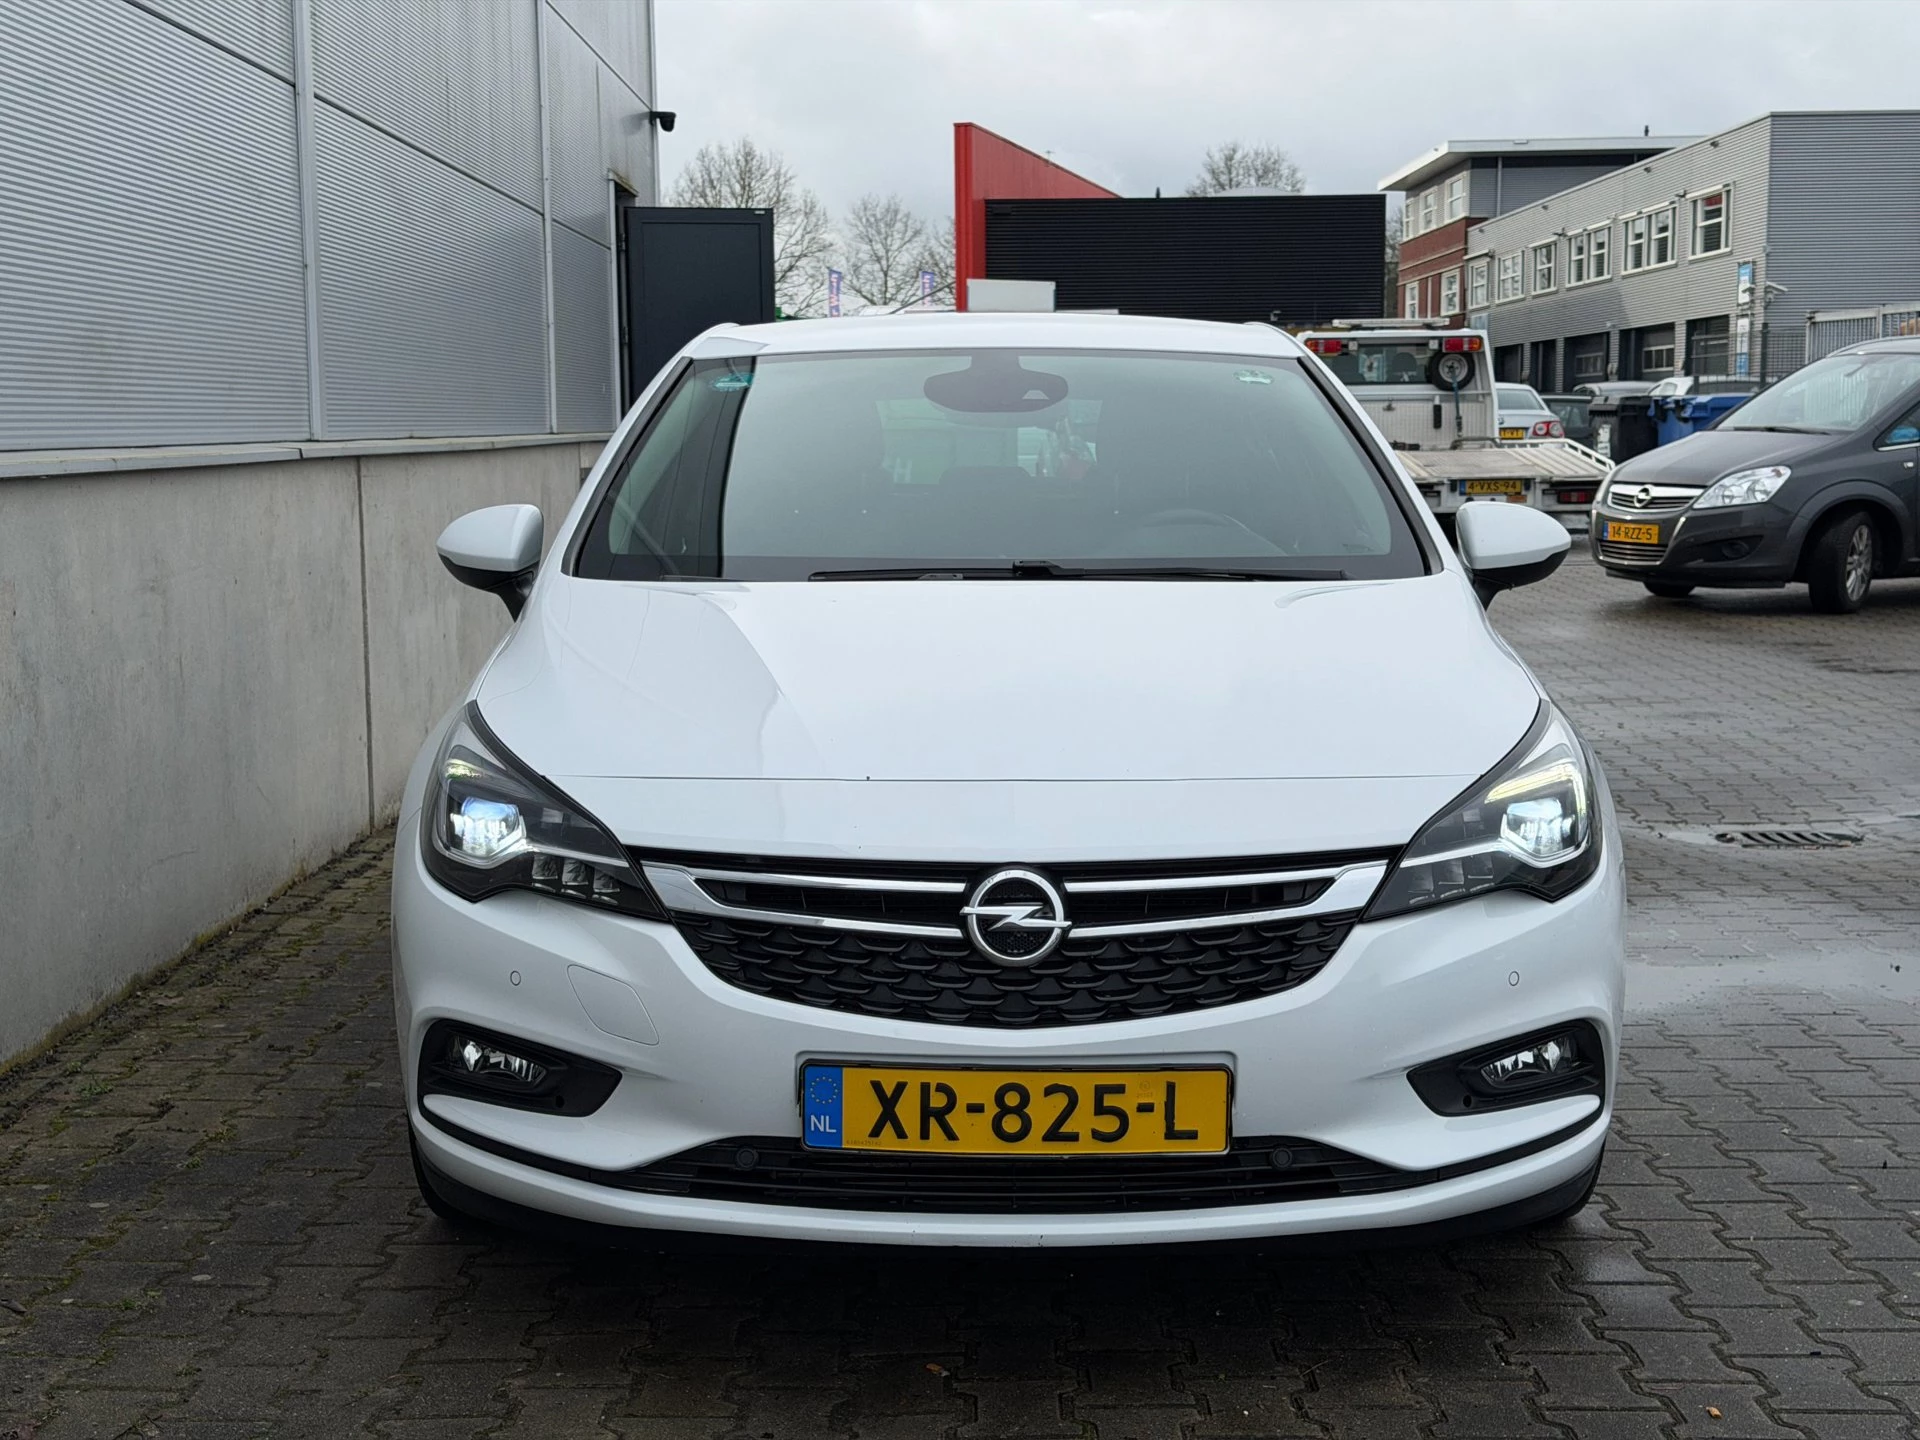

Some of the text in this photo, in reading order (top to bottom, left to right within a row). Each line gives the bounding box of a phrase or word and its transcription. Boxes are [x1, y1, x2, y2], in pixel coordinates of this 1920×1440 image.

[1611, 525, 1653, 541] 14-RZZ-5
[868, 1080, 1198, 1142] XR-825-L
[810, 1114, 837, 1133] NL
